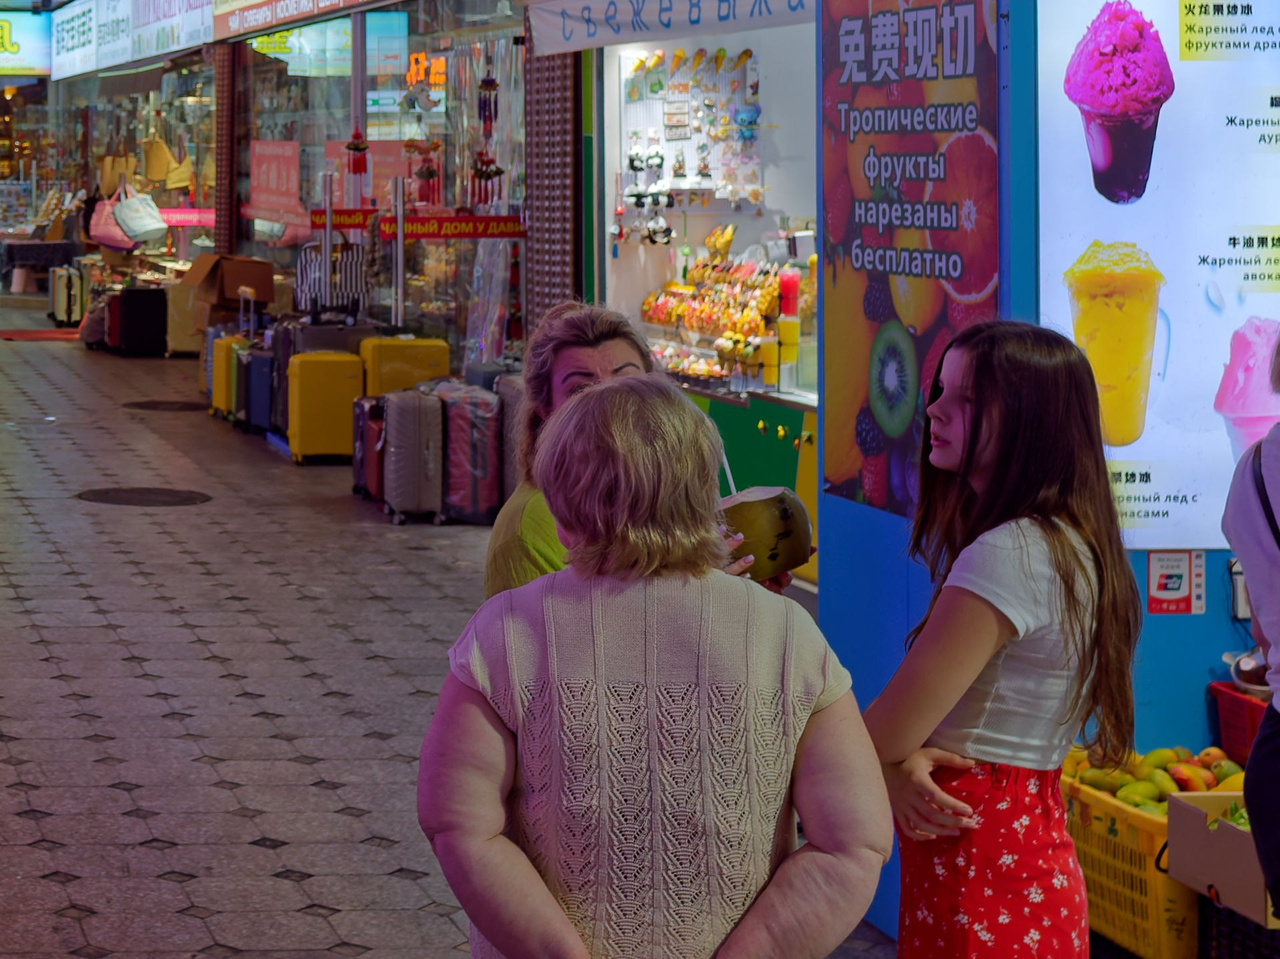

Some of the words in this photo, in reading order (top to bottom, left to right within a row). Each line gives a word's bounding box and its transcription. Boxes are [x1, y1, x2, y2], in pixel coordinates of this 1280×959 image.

[1184, 23, 1248, 36] Жареный
[1251, 26, 1274, 36] лед
[838, 3, 976, 84] 免费现切
[1184, 39, 1251, 52] фруктами
[837, 103, 977, 141] Тропические
[864, 147, 945, 187] фрукты
[381, 219, 438, 235] ЧАНЫЙ
[440, 222, 474, 236] ДОМ
[476, 222, 484, 234] У
[854, 200, 957, 234] нарезаны
[851, 238, 962, 278] бесплатно
[1198, 255, 1261, 268] Жареный
[1164, 494, 1189, 505] лед
[1191, 494, 1198, 503] с
